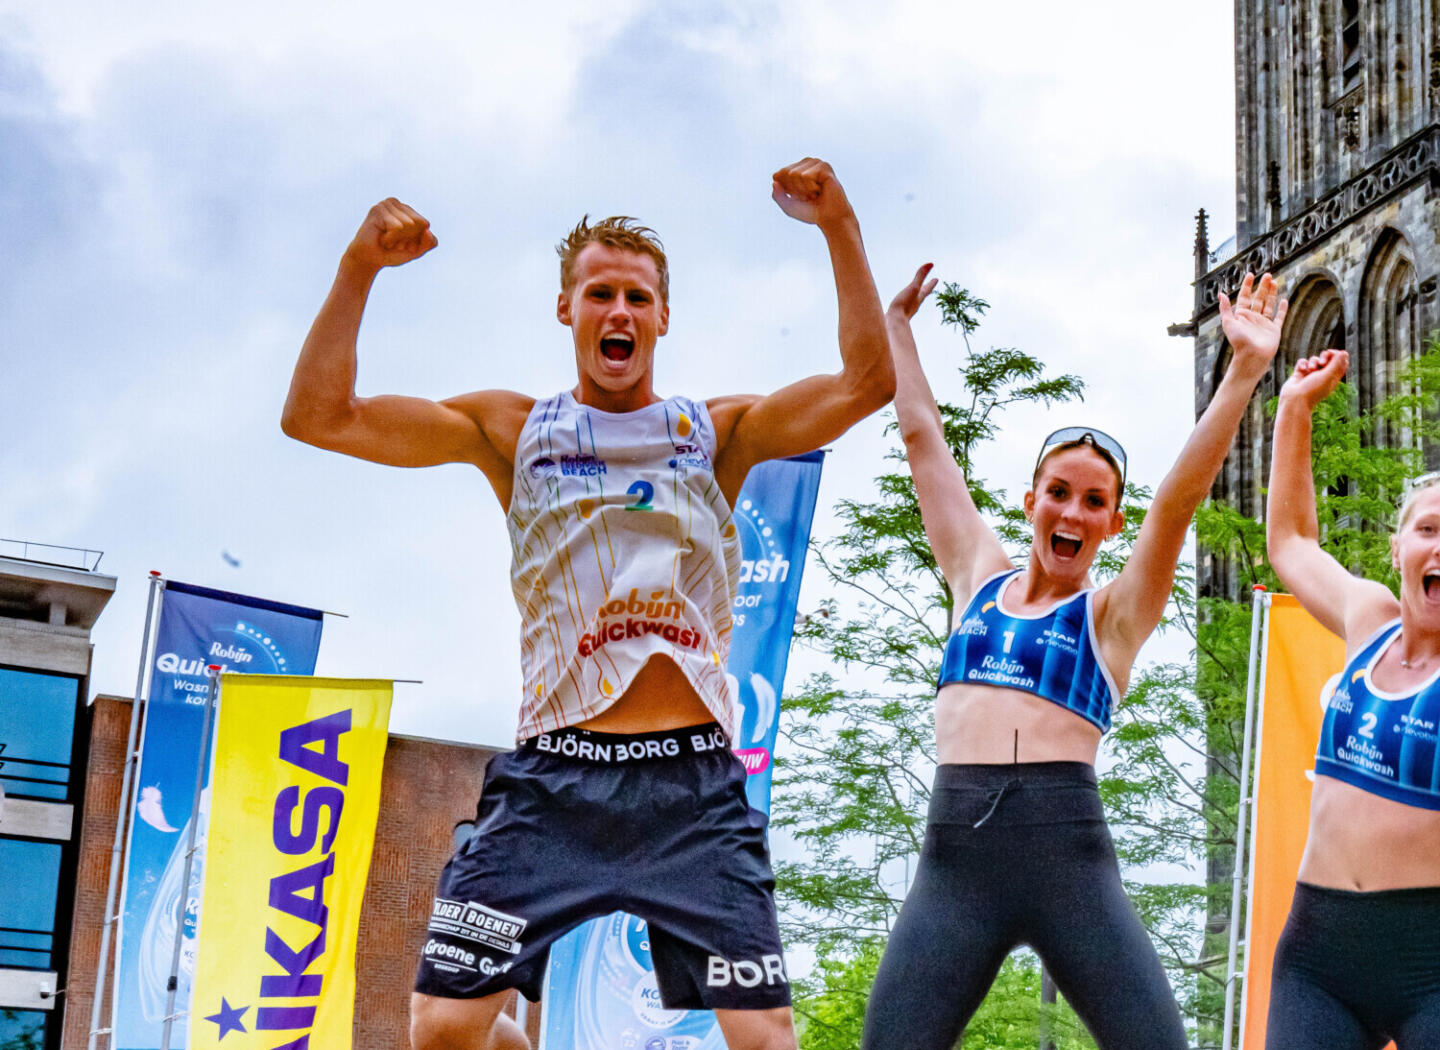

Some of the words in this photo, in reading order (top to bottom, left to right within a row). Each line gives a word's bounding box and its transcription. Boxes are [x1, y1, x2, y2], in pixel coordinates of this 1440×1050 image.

[625, 481, 654, 511] 2
[209, 642, 252, 663] Robijn
[1003, 630, 1015, 654] 1
[982, 654, 1025, 674] Robijn
[968, 668, 1035, 688] Quickwash
[1358, 712, 1378, 739] 2
[537, 733, 611, 762] BJÖRN
[616, 739, 679, 761] BORG
[690, 727, 728, 752] BJÖ
[1346, 735, 1383, 760] Robijn
[1337, 746, 1394, 777] Quickwash
[256, 708, 352, 1050] IKASA
[467, 910, 520, 938] BOENEN
[425, 939, 475, 965] Groene
